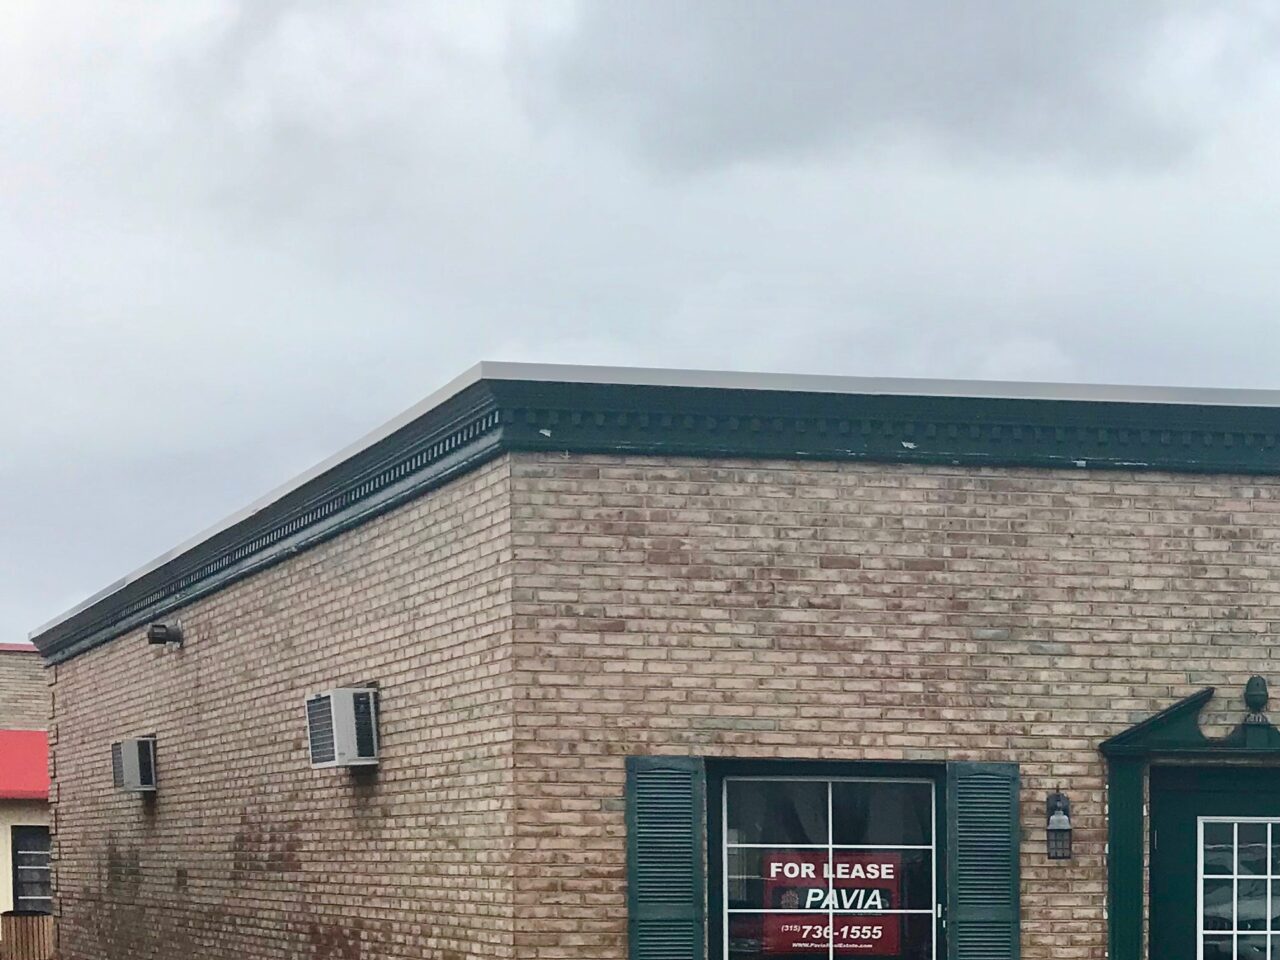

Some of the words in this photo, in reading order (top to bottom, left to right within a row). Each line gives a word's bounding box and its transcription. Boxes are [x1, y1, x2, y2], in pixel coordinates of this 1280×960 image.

[770, 862, 816, 878] FOR
[823, 863, 894, 879] LEASE
[805, 888, 883, 909] PAVIA
[781, 924, 801, 933] (315)
[801, 925, 883, 939] 736-1555
